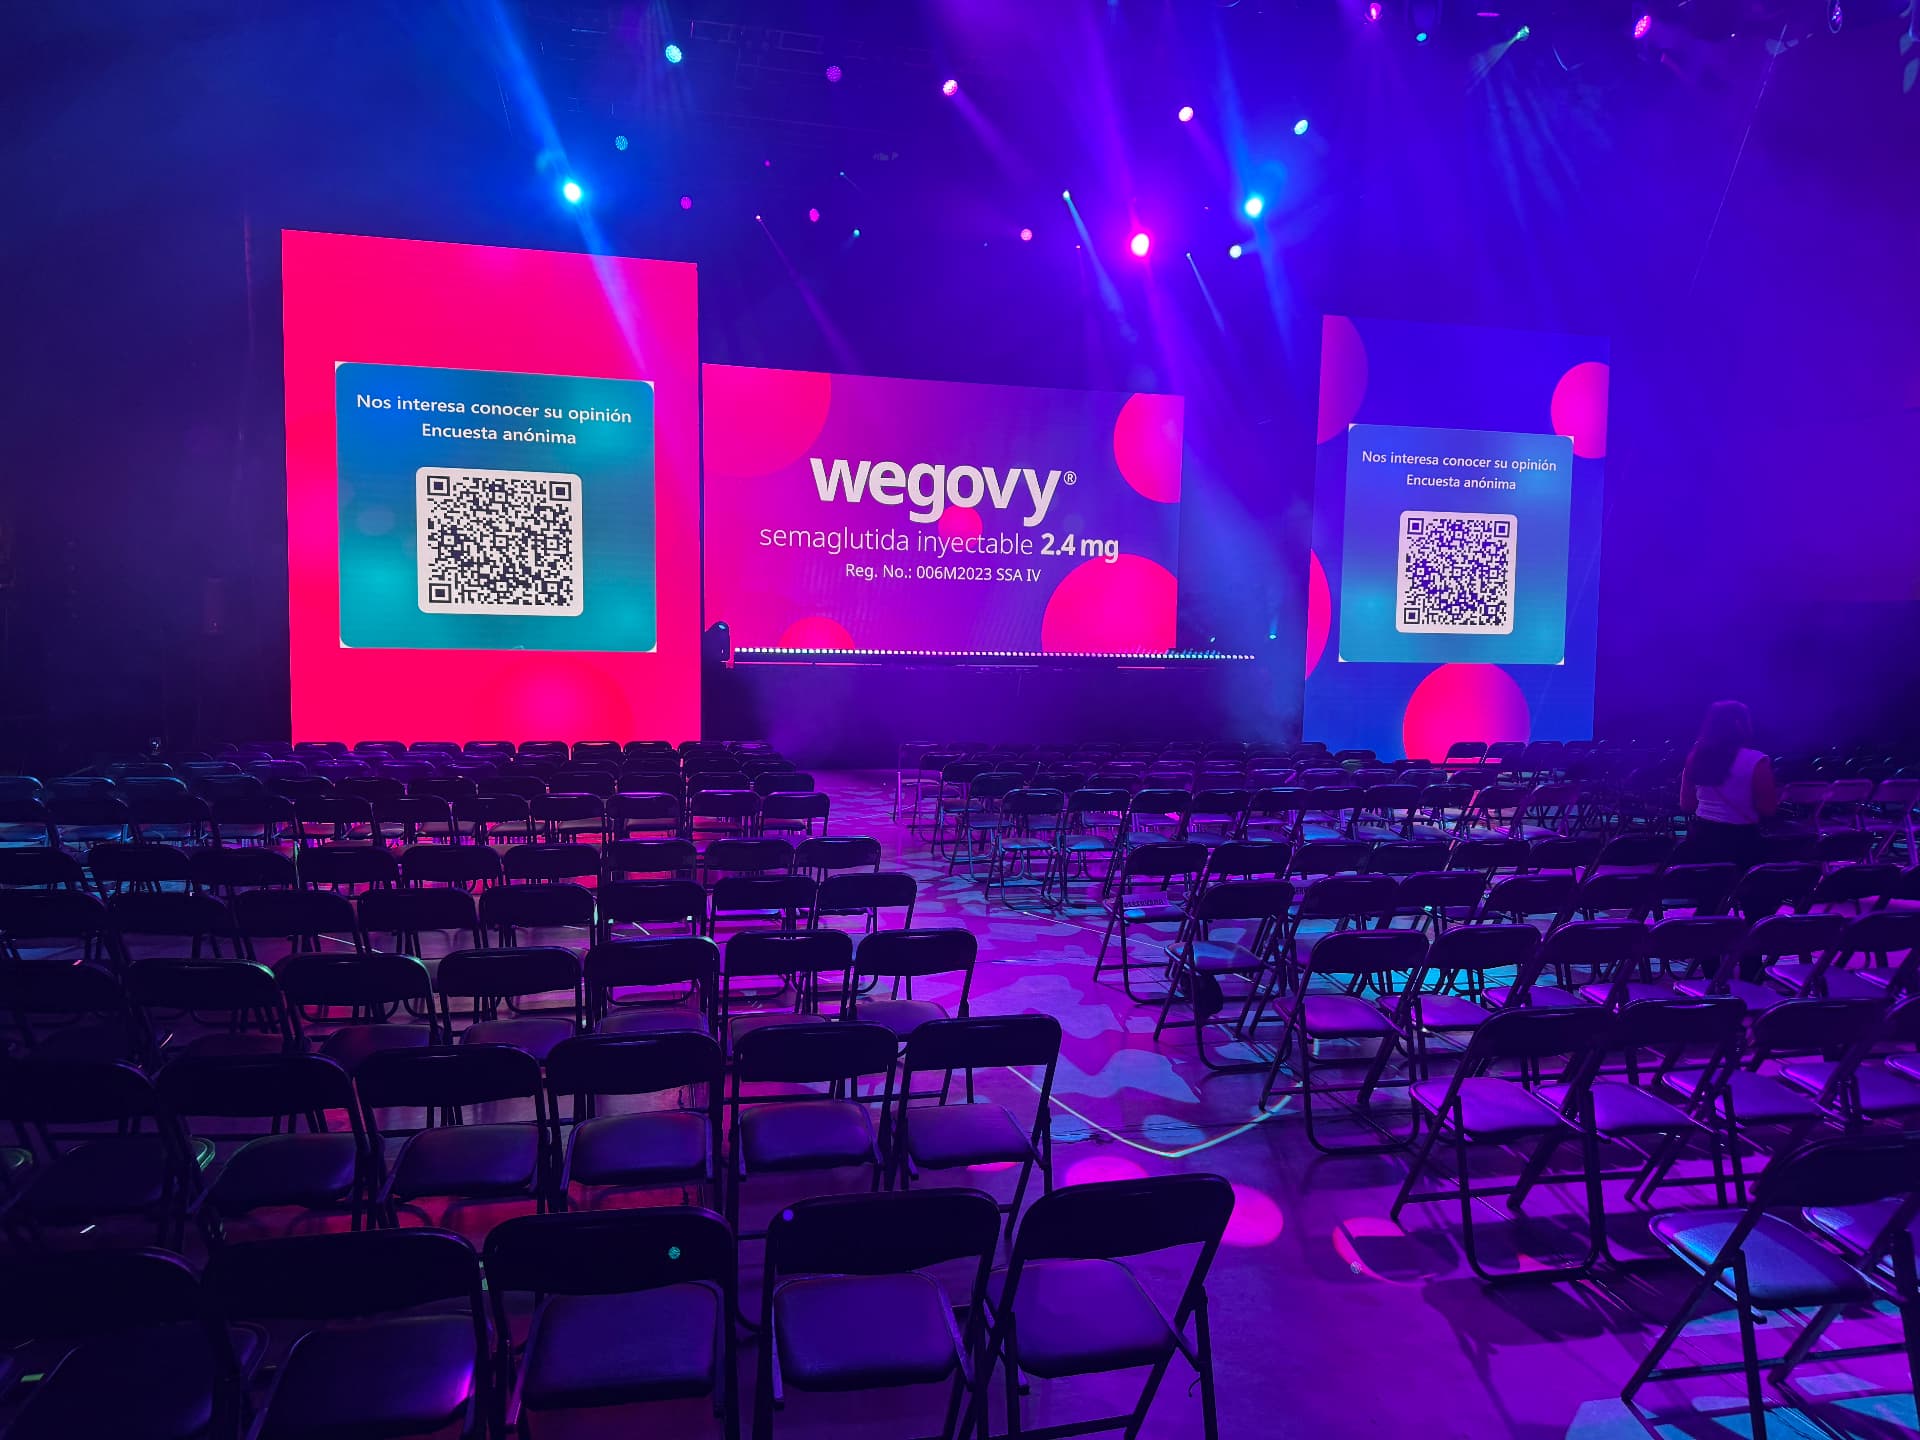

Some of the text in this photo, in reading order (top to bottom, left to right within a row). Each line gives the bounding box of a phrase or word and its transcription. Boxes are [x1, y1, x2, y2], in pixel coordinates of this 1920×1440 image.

[356, 394, 632, 424] Nos interesa conocer su opinión
[422, 423, 577, 445] Encuesta anónima
[1362, 450, 1557, 473] Nos interesa conocer su opinión
[1406, 473, 1517, 490] Encuesta anónima
[759, 526, 1119, 564] semaglutida inyectable 2.4 mg
[845, 563, 1042, 583] Reg. No.: 006M2023 SSA IV
